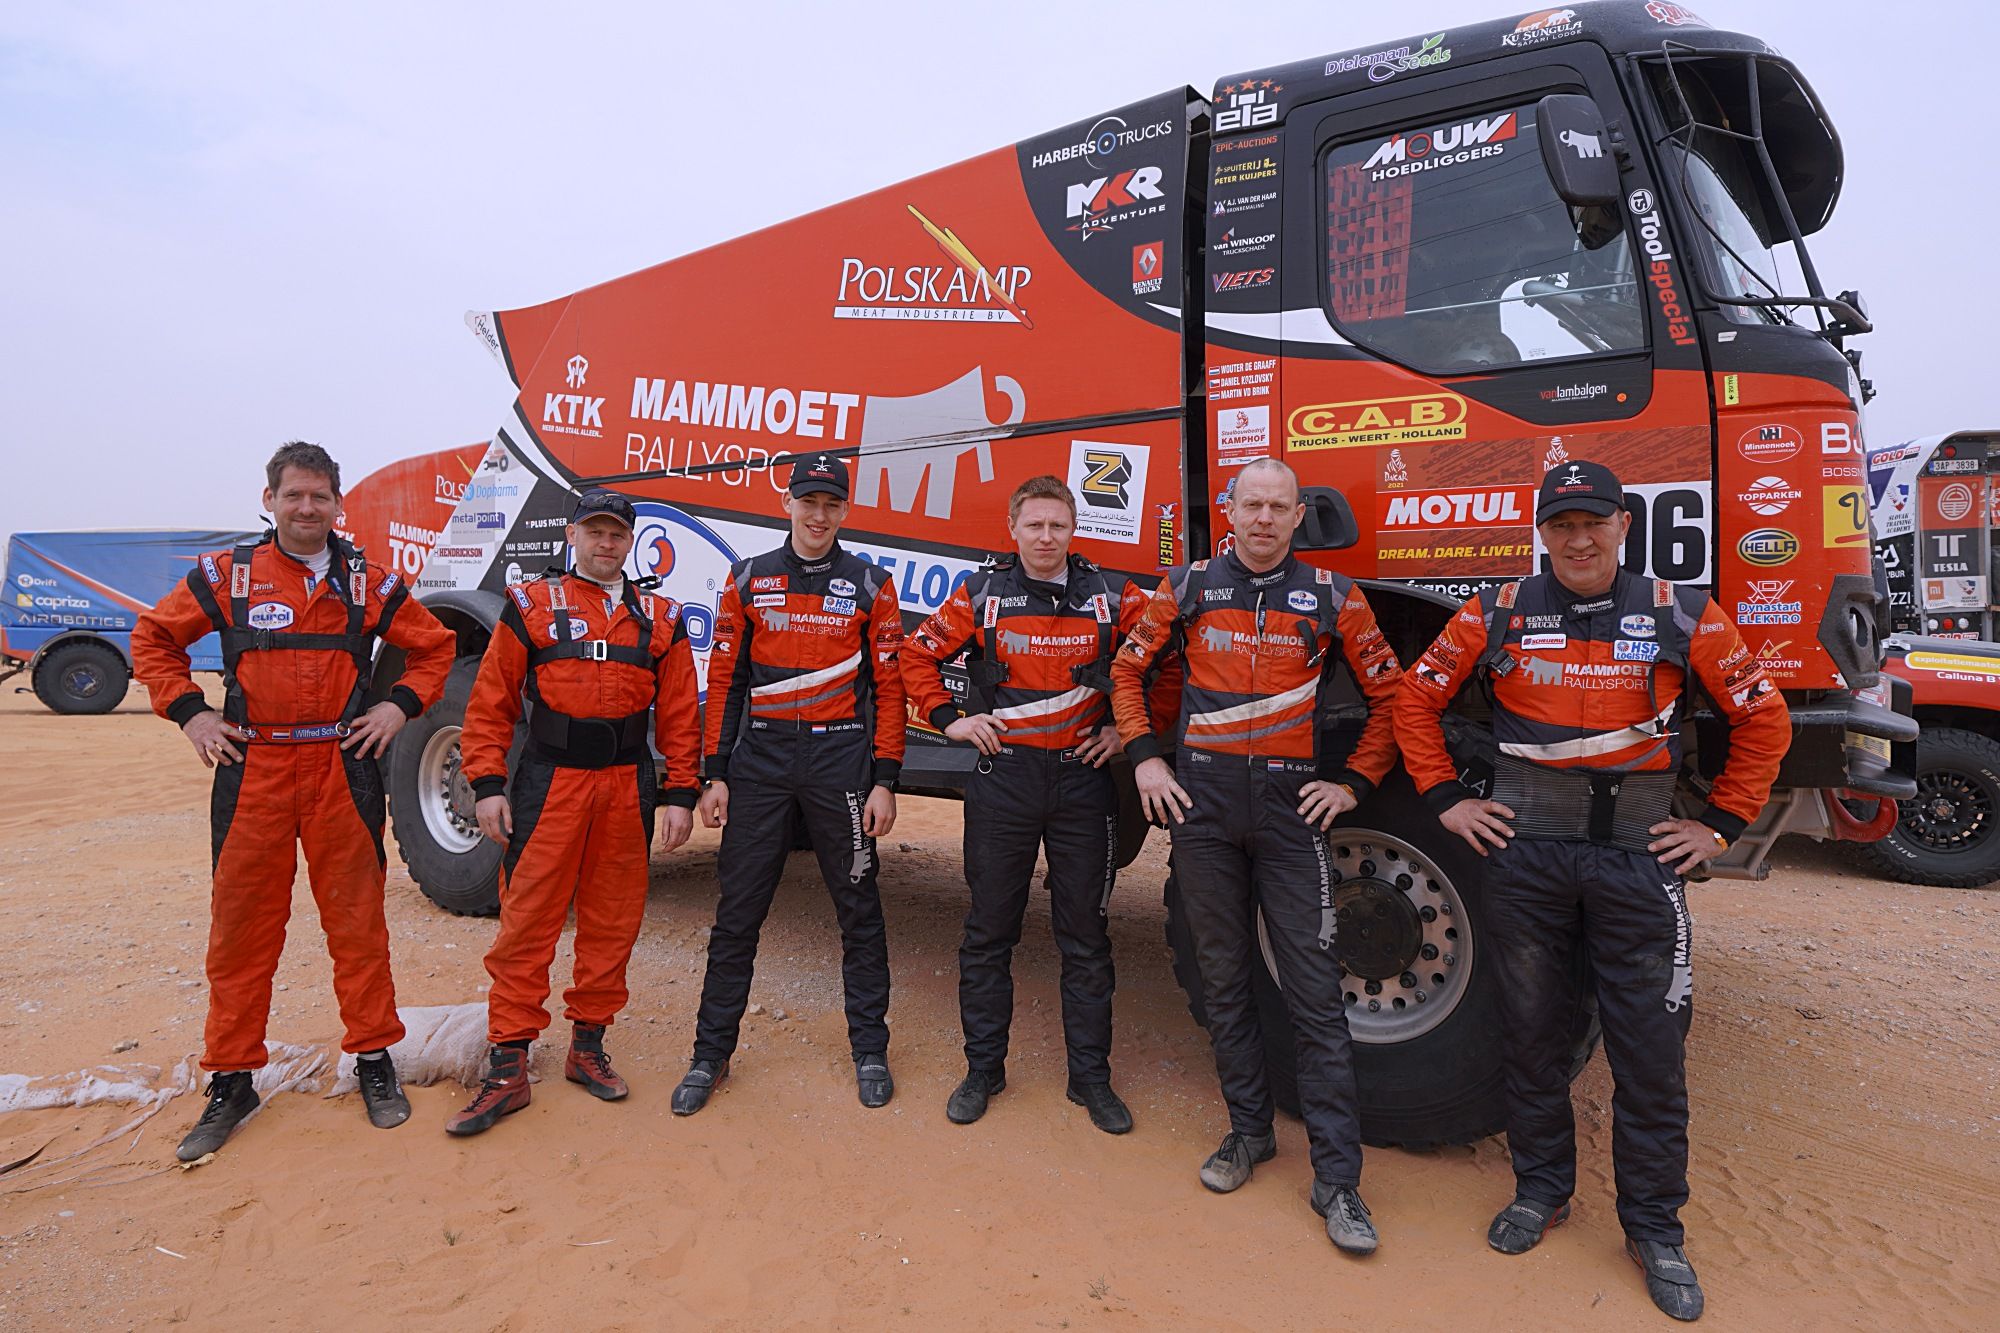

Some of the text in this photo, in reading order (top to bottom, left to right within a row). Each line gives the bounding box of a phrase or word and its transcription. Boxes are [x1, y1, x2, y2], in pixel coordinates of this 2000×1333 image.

[1523, 21, 1582, 39] SUNGULA
[1518, 37, 1549, 47] SAFARI
[1325, 47, 1409, 75] Dieleman
[1399, 49, 1451, 72] Seeds
[1032, 121, 1172, 168] HARBERS TRUCKS
[1216, 136, 1277, 152] EPIC-AUCTIONS
[1361, 113, 1511, 170] MOUW
[1372, 143, 1503, 182] HOEDLIGGERS
[1215, 170, 1277, 185] PETER KUIJPERS
[1238, 196, 1249, 204] VAN
[1250, 194, 1260, 202] DER
[1261, 192, 1277, 201] HAAR
[1082, 205, 1165, 229] ADVENTURE
[1214, 233, 1275, 250] van WINKOOP
[1223, 245, 1266, 255] TRUCKSCHADE
[838, 258, 1032, 303] POLSKAMP
[1133, 278, 1162, 290] RENAULT
[1213, 267, 1274, 293] VIETS
[1134, 285, 1161, 295] TRUCKS
[852, 308, 1004, 320] MEAT INDUSTRIE BV
[478, 319, 499, 350] Helder
[1221, 360, 1276, 373] WOUTER DE GRAAFF
[1221, 377, 1240, 387] DANIEL
[1221, 390, 1242, 399] MARTIN
[1253, 386, 1269, 395] BRINK
[544, 393, 606, 428] KTK
[630, 377, 859, 440] MAMMOET
[1222, 435, 1265, 444] KAMPHOF
[1292, 428, 1462, 447] TRUCKS WEERT HOLLAND
[1872, 449, 1905, 464] GOLD
[1385, 471, 1407, 482] DAKAR
[477, 484, 518, 499] Dopharma
[1738, 490, 1801, 501] TOPPARKEN
[1385, 492, 1522, 526] MOTUL
[531, 518, 567, 528] PLUS PATER
[1095, 528, 1133, 536] TRACTOR
[1161, 520, 1173, 566] REIGER
[1745, 540, 1796, 553] HELLA
[440, 548, 482, 558] HENDRICKSON
[1379, 545, 1533, 560] DREAM. DARE. LIVE IT.
[1933, 563, 1968, 572] TESLA
[33, 578, 56, 586] Drift
[422, 580, 456, 588] MERITOR
[754, 578, 781, 588] MOVE
[831, 584, 854, 593] eurol
[35, 596, 89, 610] capriza
[836, 599, 854, 609] HSF
[1738, 601, 1801, 613] Dynastart
[252, 613, 289, 621] eurol
[824, 606, 853, 615] LOGISTICS
[19, 613, 125, 627] AIROBOTICS
[791, 614, 850, 626] MAMMOET
[1738, 614, 1801, 625] ELEKTRO
[790, 624, 848, 637] RALLYSPORT
[1031, 635, 1095, 646] MAMMOET
[1631, 642, 1660, 654] HSF
[1565, 663, 1651, 676] MAMMOET
[1937, 671, 1982, 682] Calluna
[296, 729, 319, 737] Wilfred
[921, 734, 947, 744] COMPANIES
[846, 792, 863, 851] MAMMOET
[1312, 834, 1330, 907] MAMMOET
[1662, 883, 1687, 965] MAMMOET
